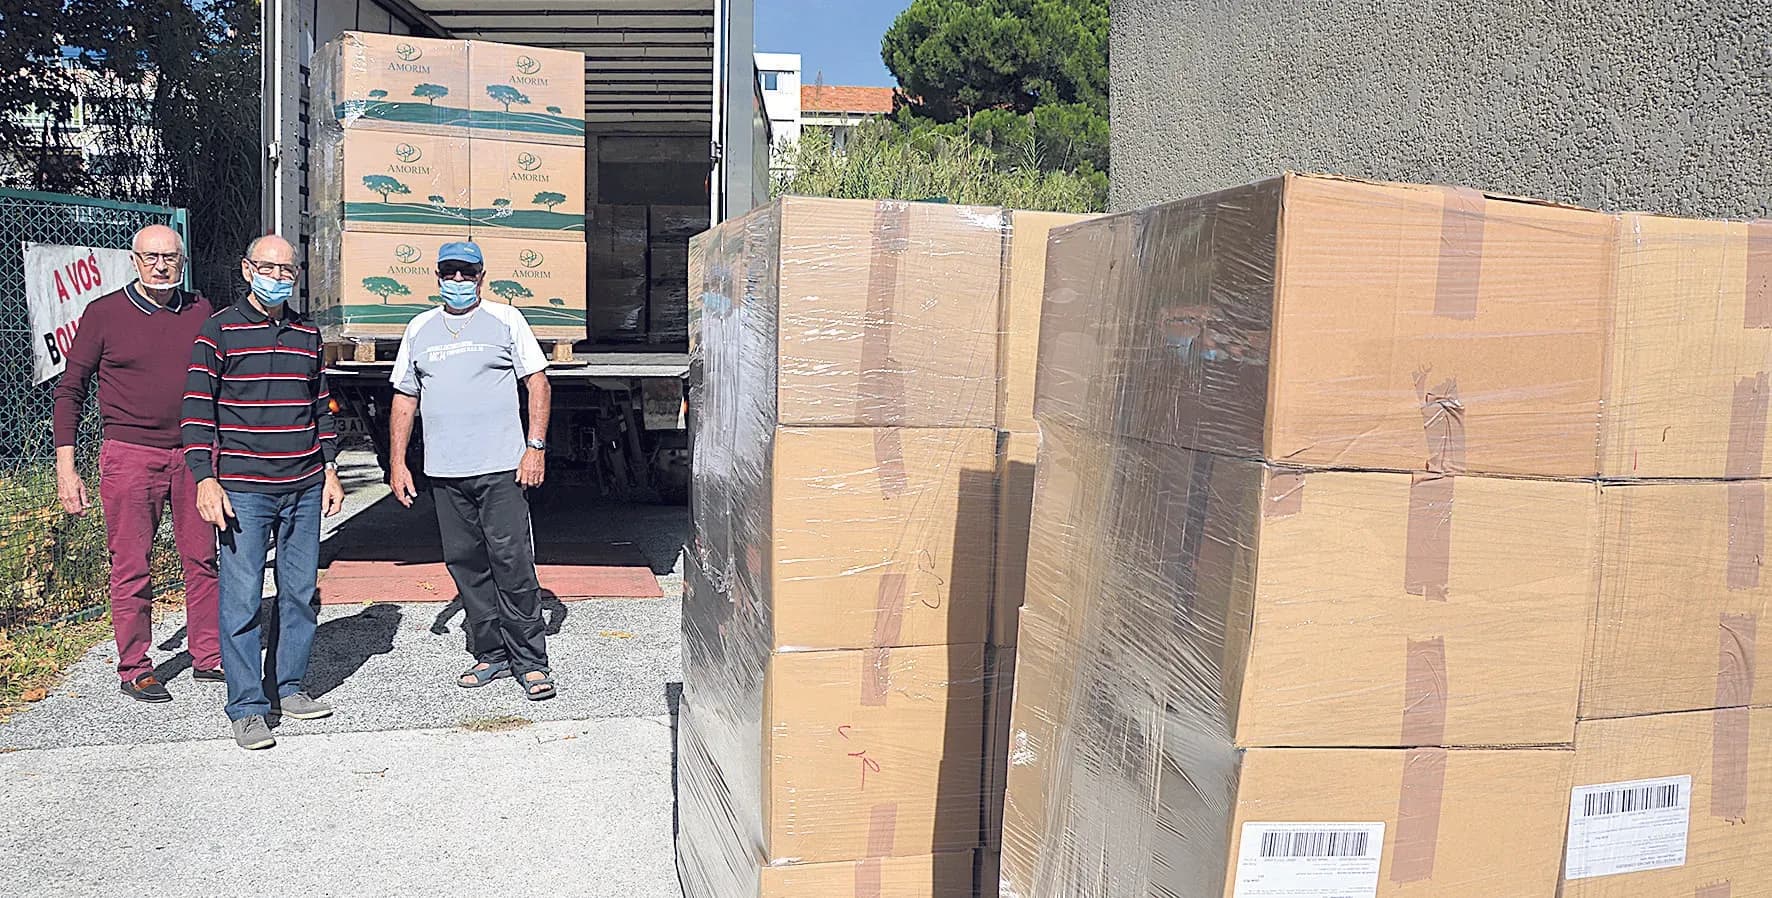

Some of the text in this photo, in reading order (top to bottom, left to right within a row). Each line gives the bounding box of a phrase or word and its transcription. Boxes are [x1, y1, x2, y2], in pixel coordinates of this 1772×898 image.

[387, 62, 431, 75] AMORIM
[508, 75, 549, 87] AMORIM
[387, 163, 431, 176] AMORIM
[510, 171, 550, 183] AMORIM
[387, 264, 430, 275] AMORIM
[511, 268, 551, 279] AMORIM
[53, 254, 102, 304] A VOS
